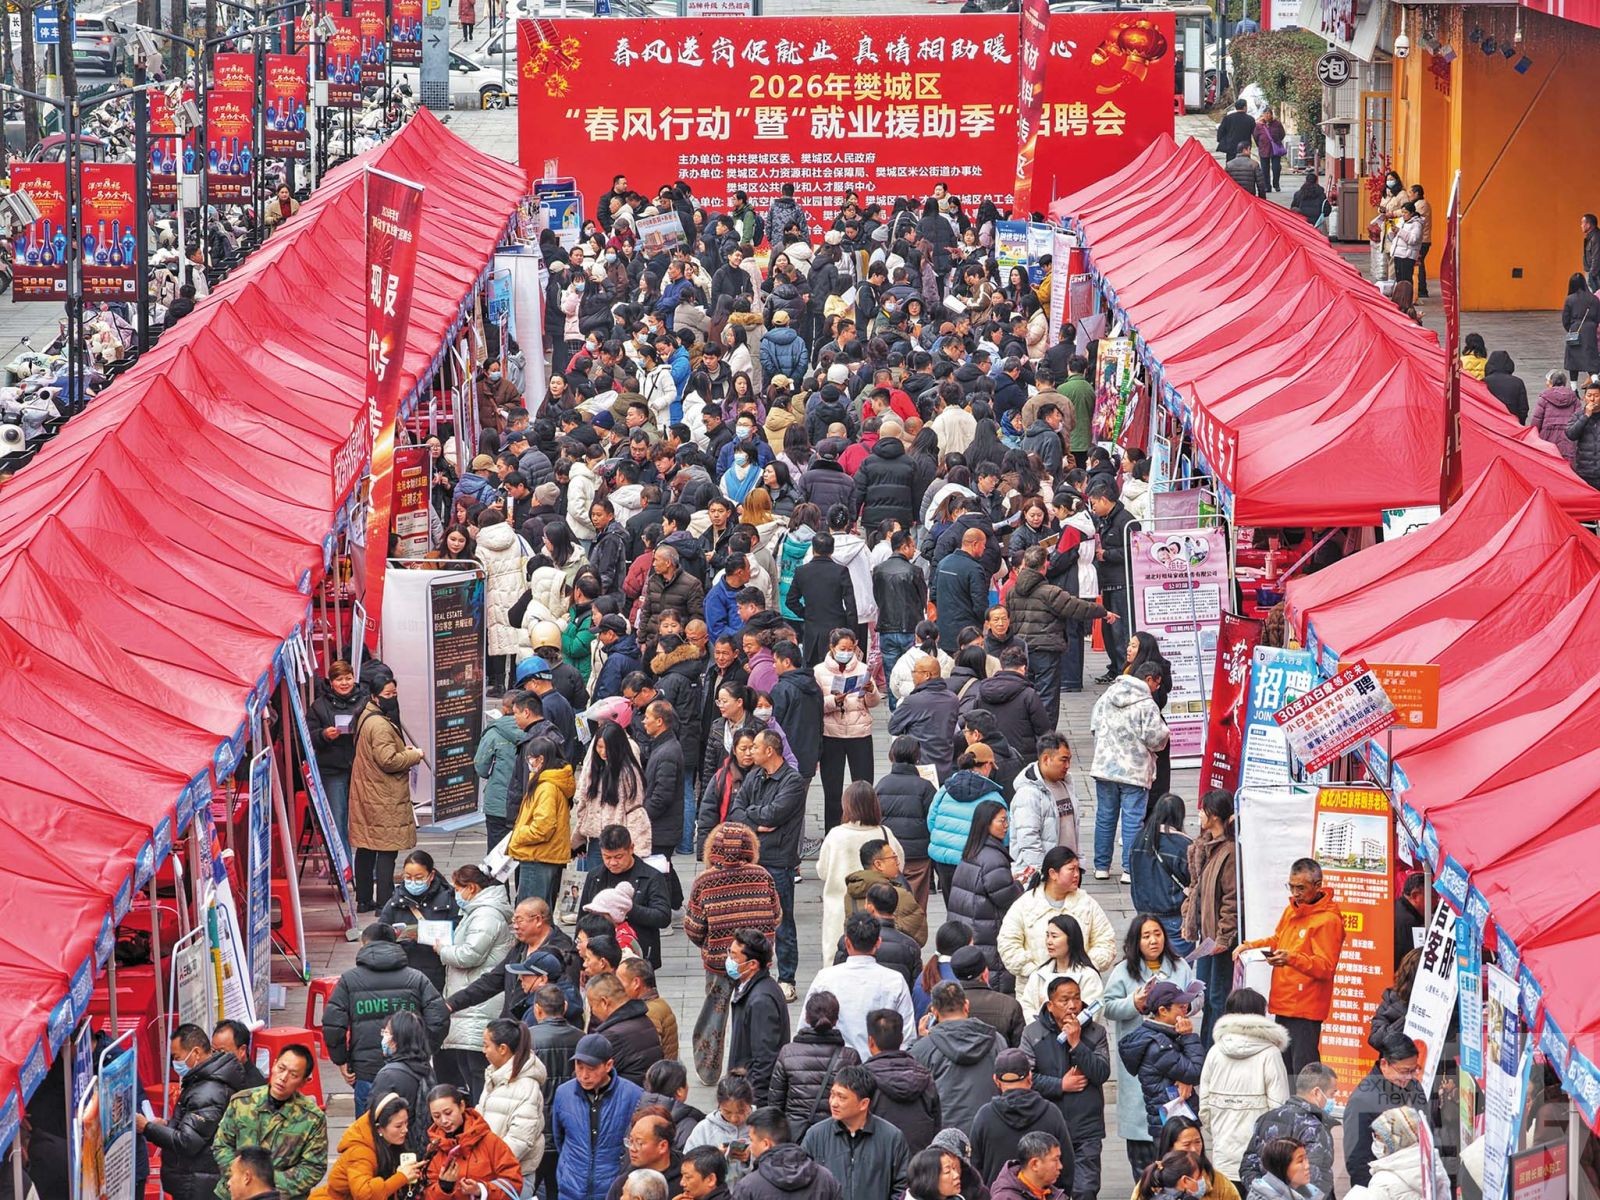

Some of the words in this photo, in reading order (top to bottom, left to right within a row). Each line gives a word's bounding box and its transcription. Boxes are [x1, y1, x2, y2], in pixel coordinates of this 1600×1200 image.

[611, 36, 838, 67] 春风送岗促就业
[852, 33, 1078, 66] 真情相助暖心
[1319, 59, 1348, 80] 泡
[749, 72, 942, 101] 2026年樊城区
[434, 611, 446, 620] REAL
[446, 609, 463, 619] ESTATE
[1277, 663, 1365, 722] 30年小白象等你来
[1353, 674, 1376, 696] 聘
[1253, 710, 1272, 721] JOIN
[356, 997, 389, 1015] COVE
